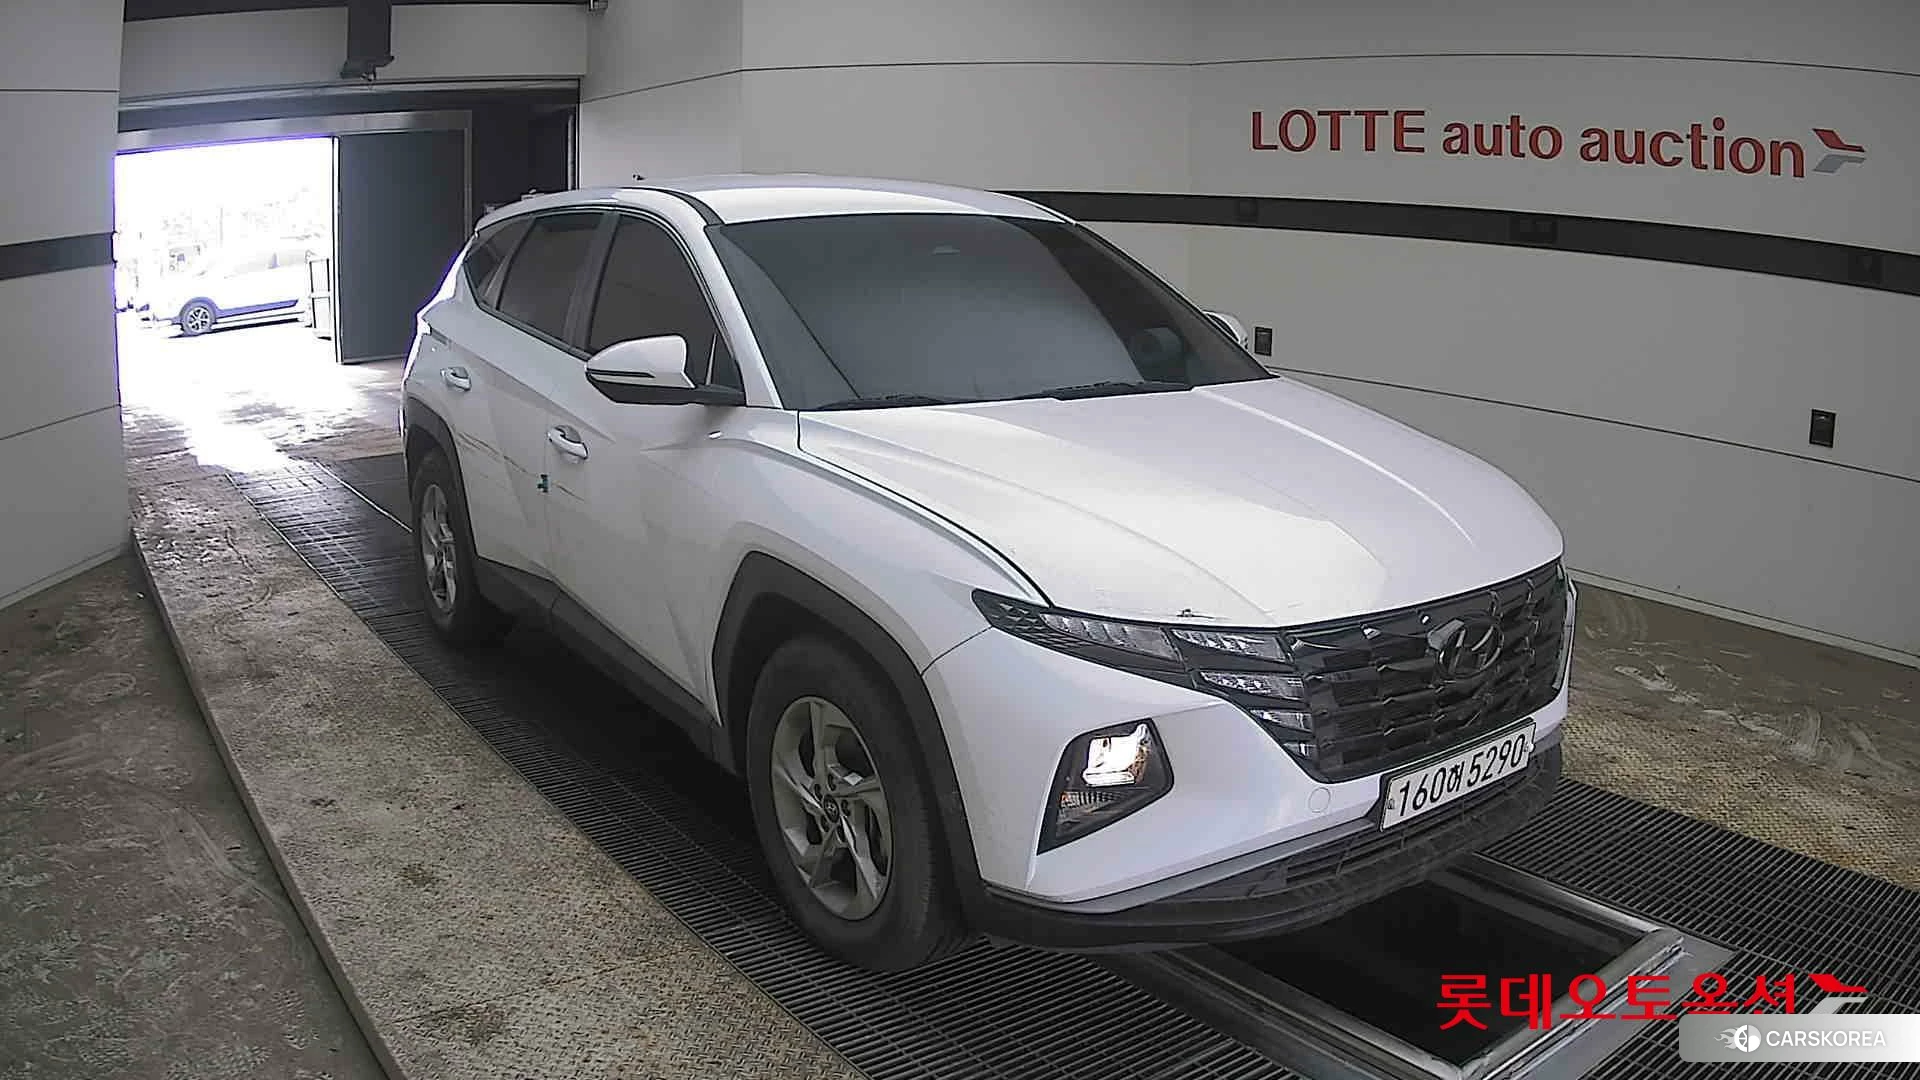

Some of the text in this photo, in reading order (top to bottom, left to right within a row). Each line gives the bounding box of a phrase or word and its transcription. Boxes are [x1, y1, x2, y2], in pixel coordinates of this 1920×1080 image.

[1251, 109, 1806, 178] LOTTE auto auction
